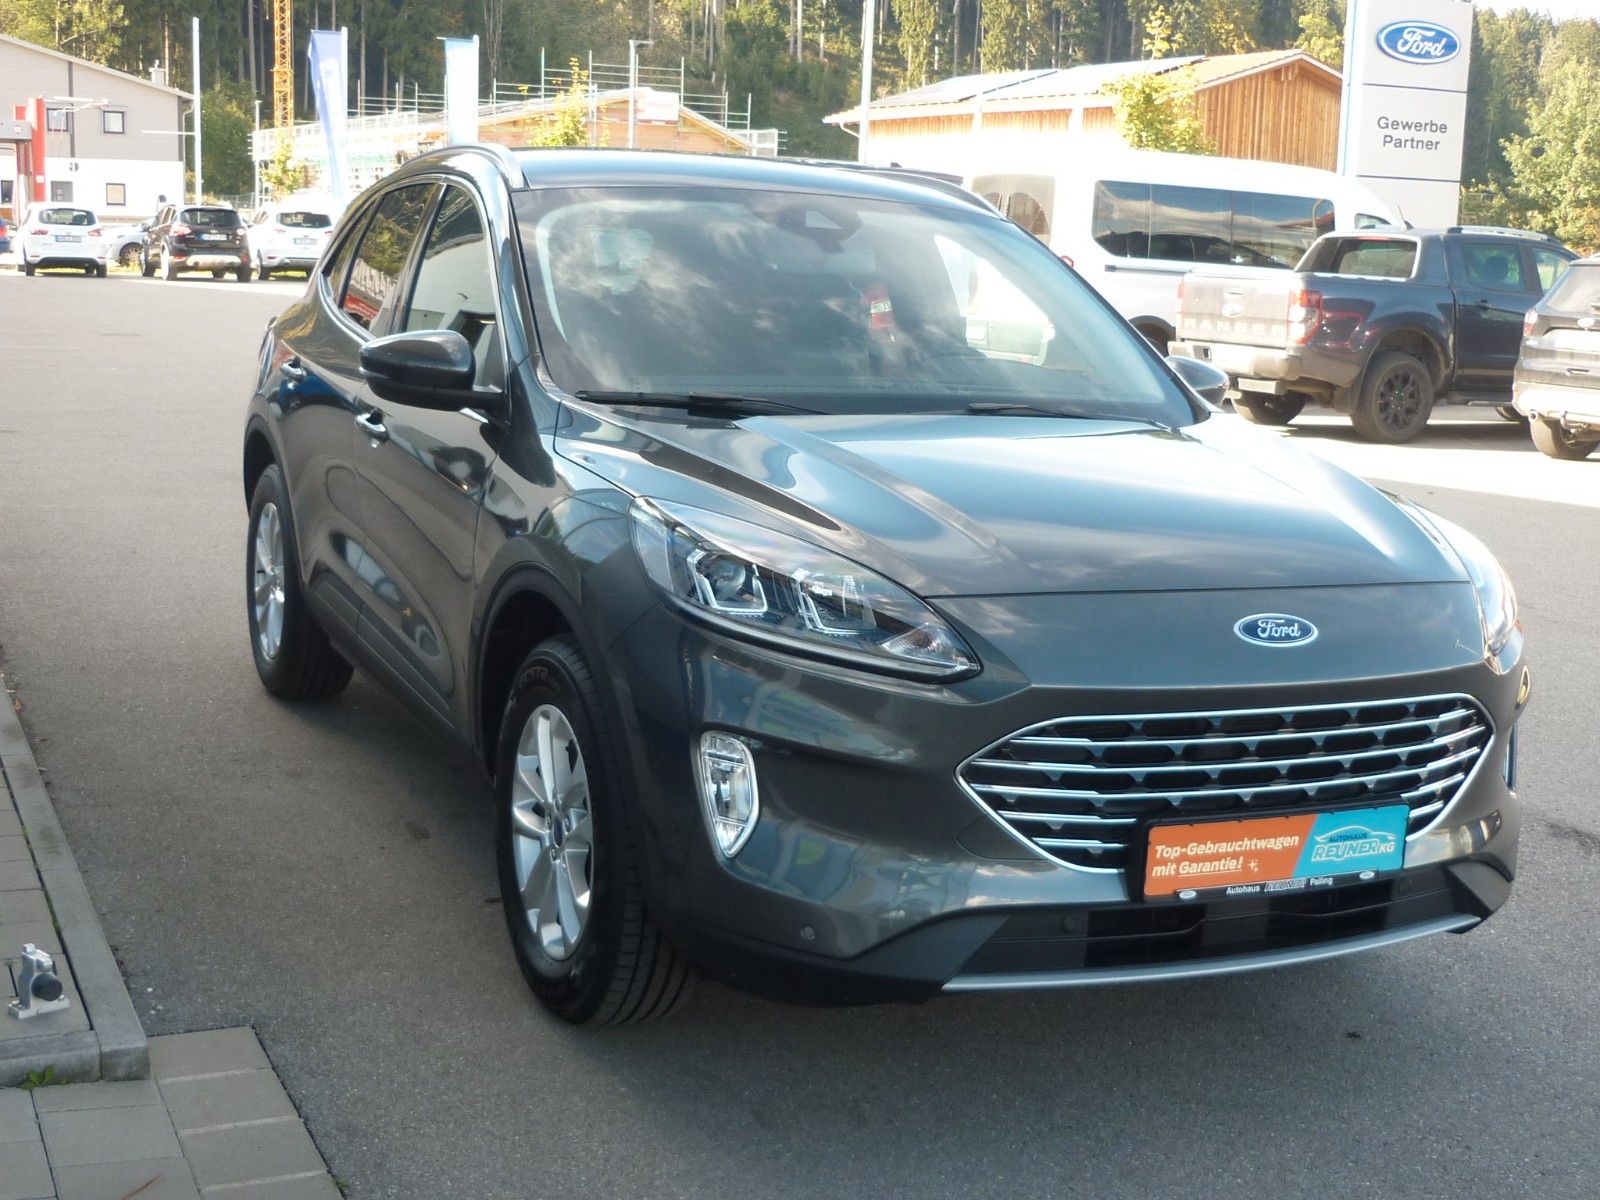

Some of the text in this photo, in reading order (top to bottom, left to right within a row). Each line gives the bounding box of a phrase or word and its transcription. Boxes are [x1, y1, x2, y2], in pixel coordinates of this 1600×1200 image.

[1397, 27, 1447, 57] Ford
[1377, 116, 1448, 134] Gewerbe
[1383, 134, 1440, 151] Partner
[1257, 618, 1301, 638] Ford
[1328, 832, 1368, 842] AUTOHAUS
[1155, 836, 1299, 859] Top-Gebrauchtwagen
[1379, 842, 1396, 854] KG
[1152, 857, 1244, 877] mit Garantie!
[1226, 885, 1260, 895] Autohaus
